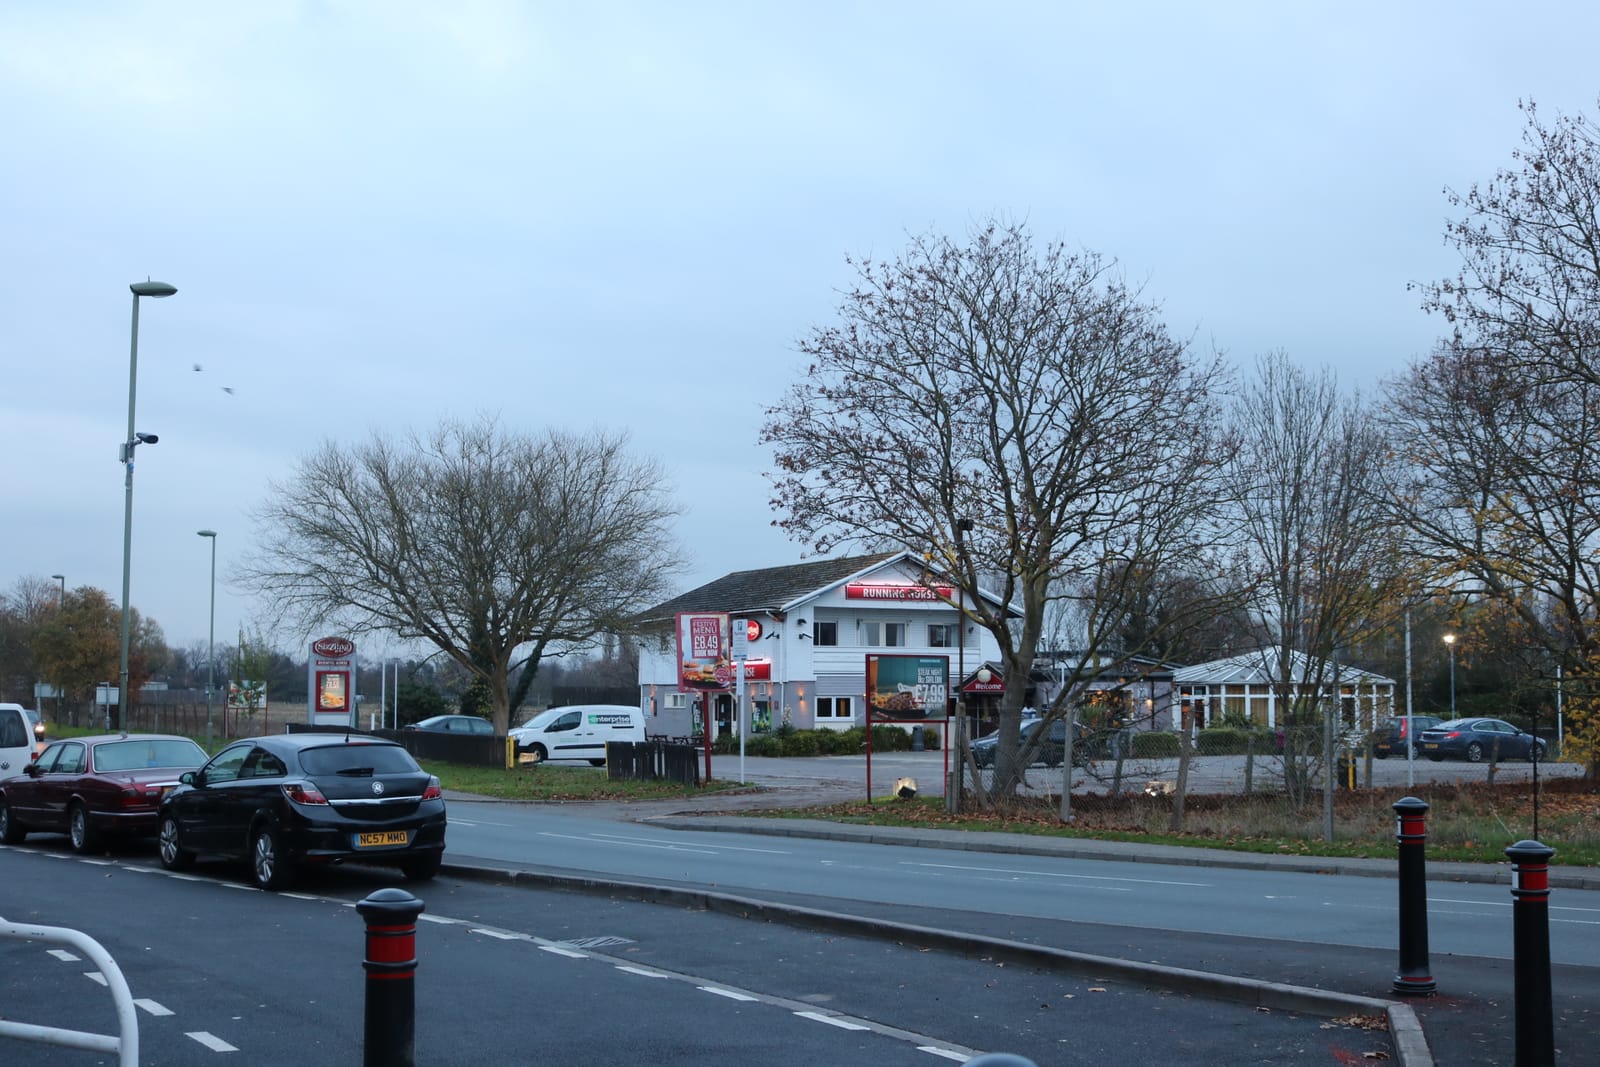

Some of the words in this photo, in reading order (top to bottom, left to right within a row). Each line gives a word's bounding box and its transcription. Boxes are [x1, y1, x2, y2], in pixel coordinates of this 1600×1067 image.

[863, 588, 905, 599] RUNNING
[694, 635, 718, 649] £8.49
[915, 684, 944, 703] £7.99
[360, 833, 385, 844] NC57
[387, 832, 406, 842] MMO
